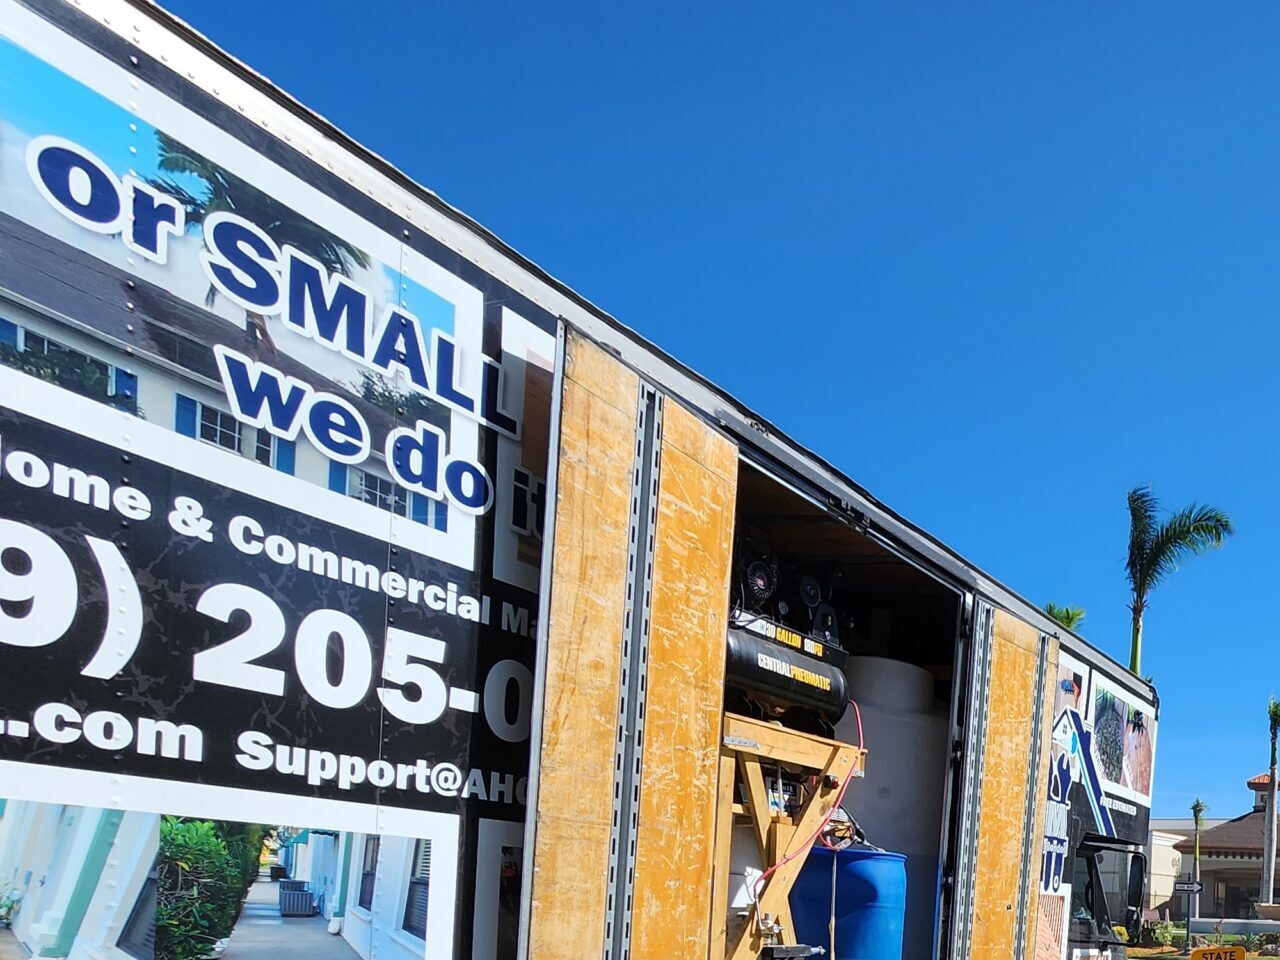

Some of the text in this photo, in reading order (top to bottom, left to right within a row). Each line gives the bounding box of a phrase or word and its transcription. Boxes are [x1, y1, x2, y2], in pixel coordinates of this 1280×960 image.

[30, 139, 520, 438] or SMALL
[217, 348, 367, 460] we
[388, 422, 492, 513] do
[0, 433, 151, 520] ome
[168, 497, 213, 543] &
[228, 515, 490, 625] Commercial
[193, 582, 534, 743] 205-0
[766, 622, 776, 639] 30
[776, 627, 801, 649] GALLON
[0, 702, 203, 762] .com
